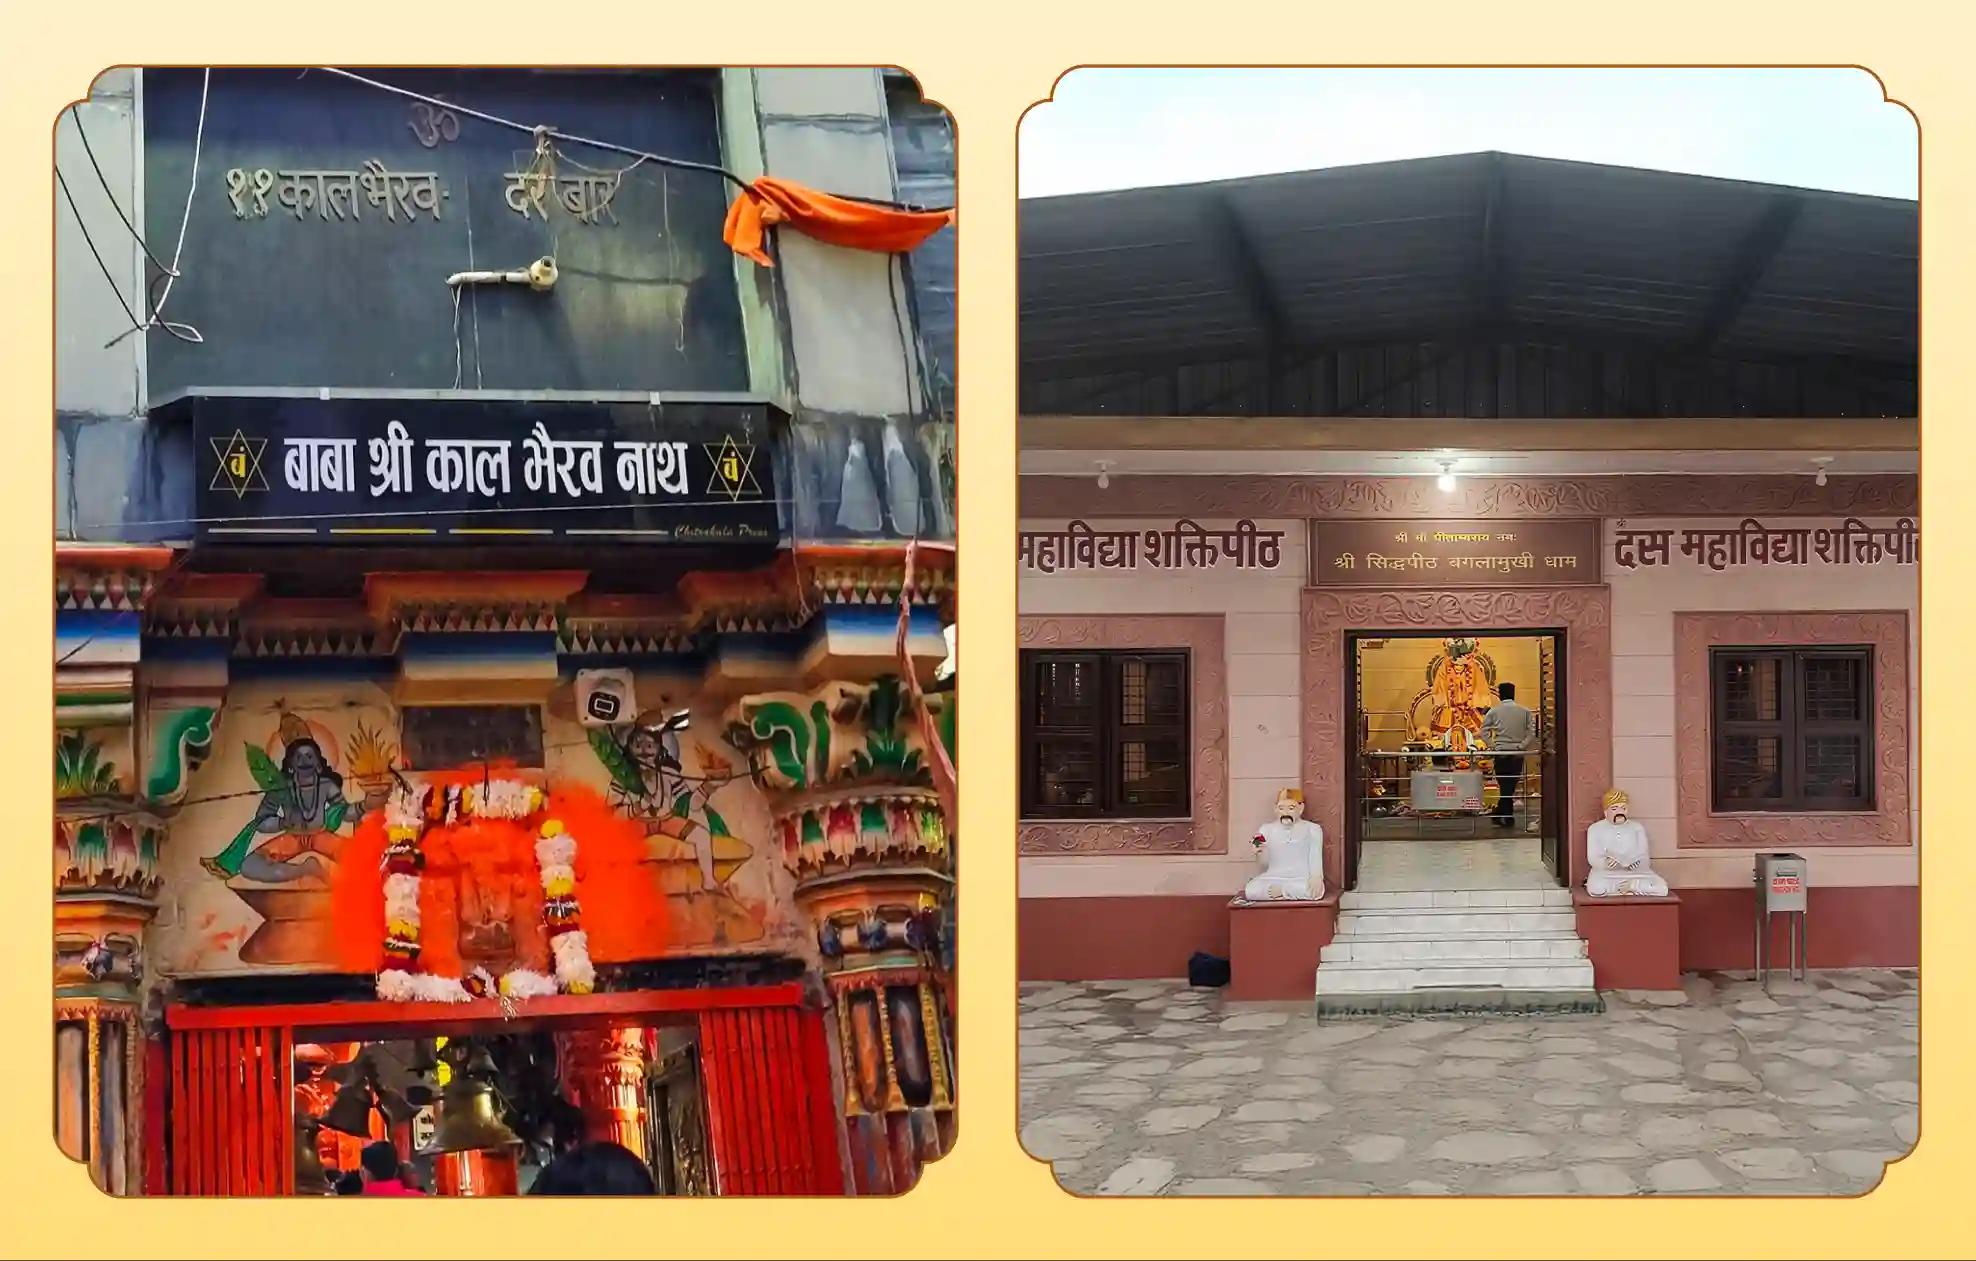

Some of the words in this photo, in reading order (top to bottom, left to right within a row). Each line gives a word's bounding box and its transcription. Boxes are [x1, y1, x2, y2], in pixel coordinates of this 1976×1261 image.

[284, 437, 358, 493] बाबा
[368, 420, 415, 497] श्री
[425, 438, 512, 497] काल
[523, 420, 604, 498] भैरव
[613, 440, 689, 495] नाथ
[1334, 552, 1356, 569] श्री
[1544, 556, 1577, 569] धाम
[1615, 529, 1675, 570] दस
[1813, 517, 1919, 566] शक्तिपी
